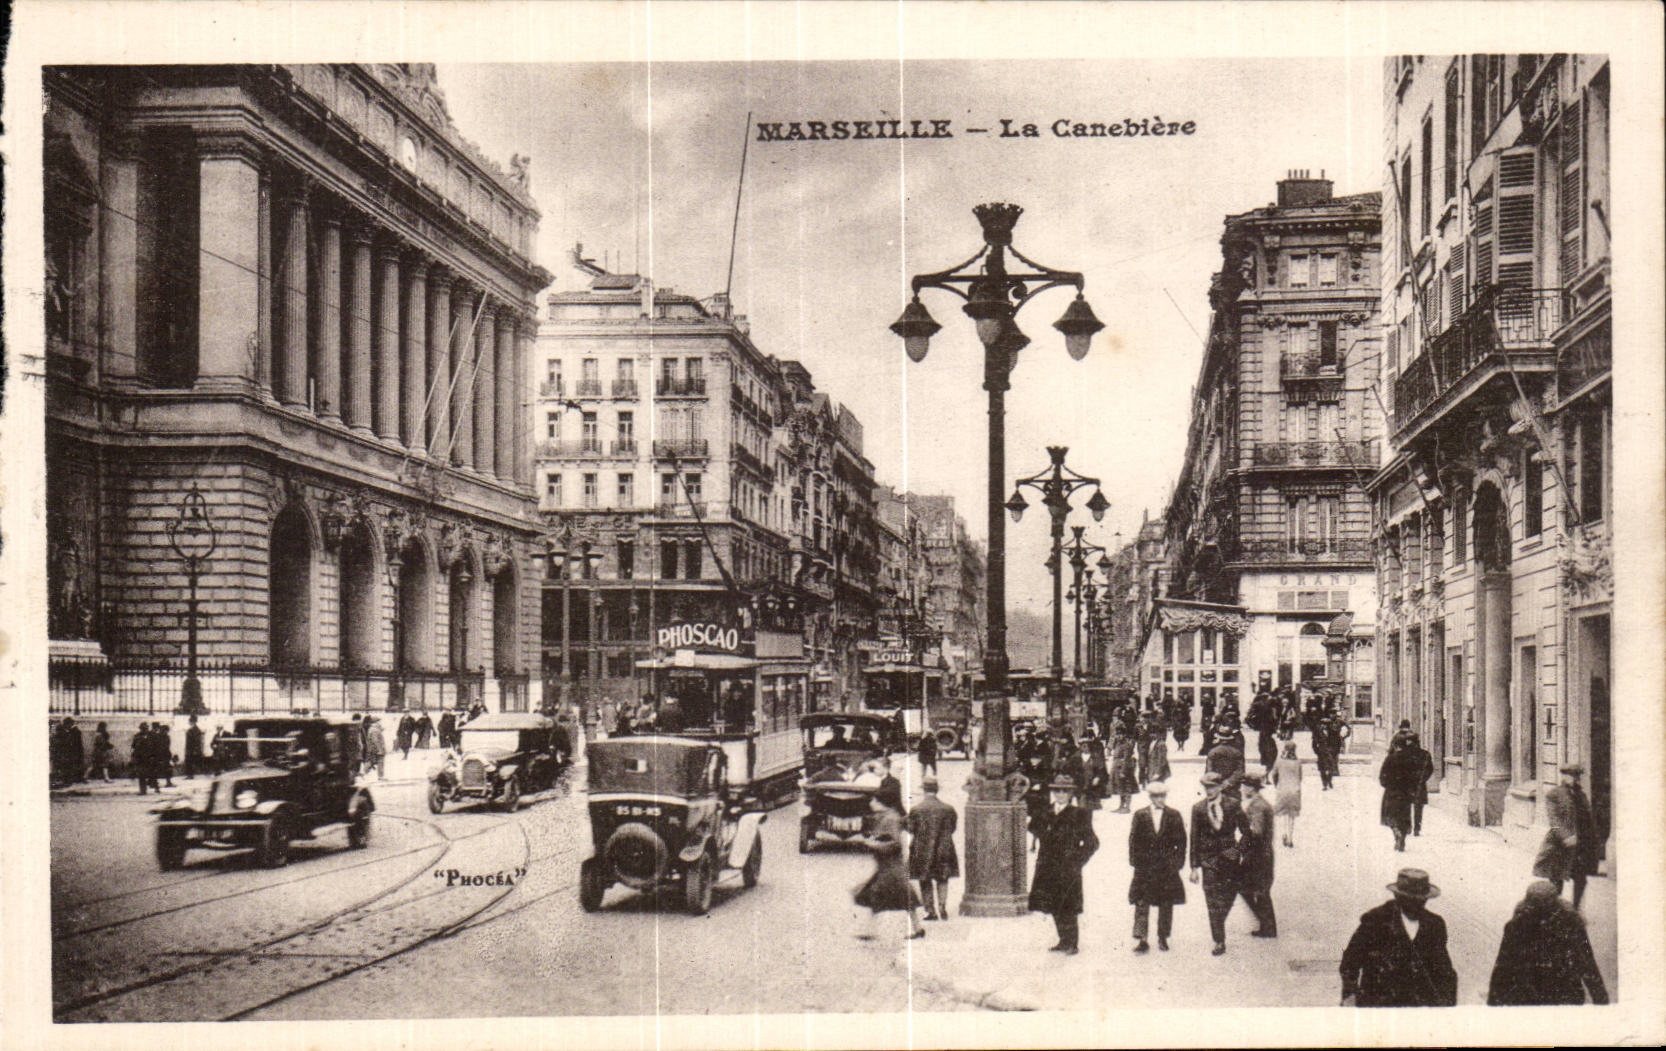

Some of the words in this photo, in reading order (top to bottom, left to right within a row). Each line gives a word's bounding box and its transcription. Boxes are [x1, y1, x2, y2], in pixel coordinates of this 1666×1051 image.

[1280, 574, 1357, 586] GRAND
[658, 623, 738, 650] PHOSCAO
[873, 652, 914, 663] LOUIT
